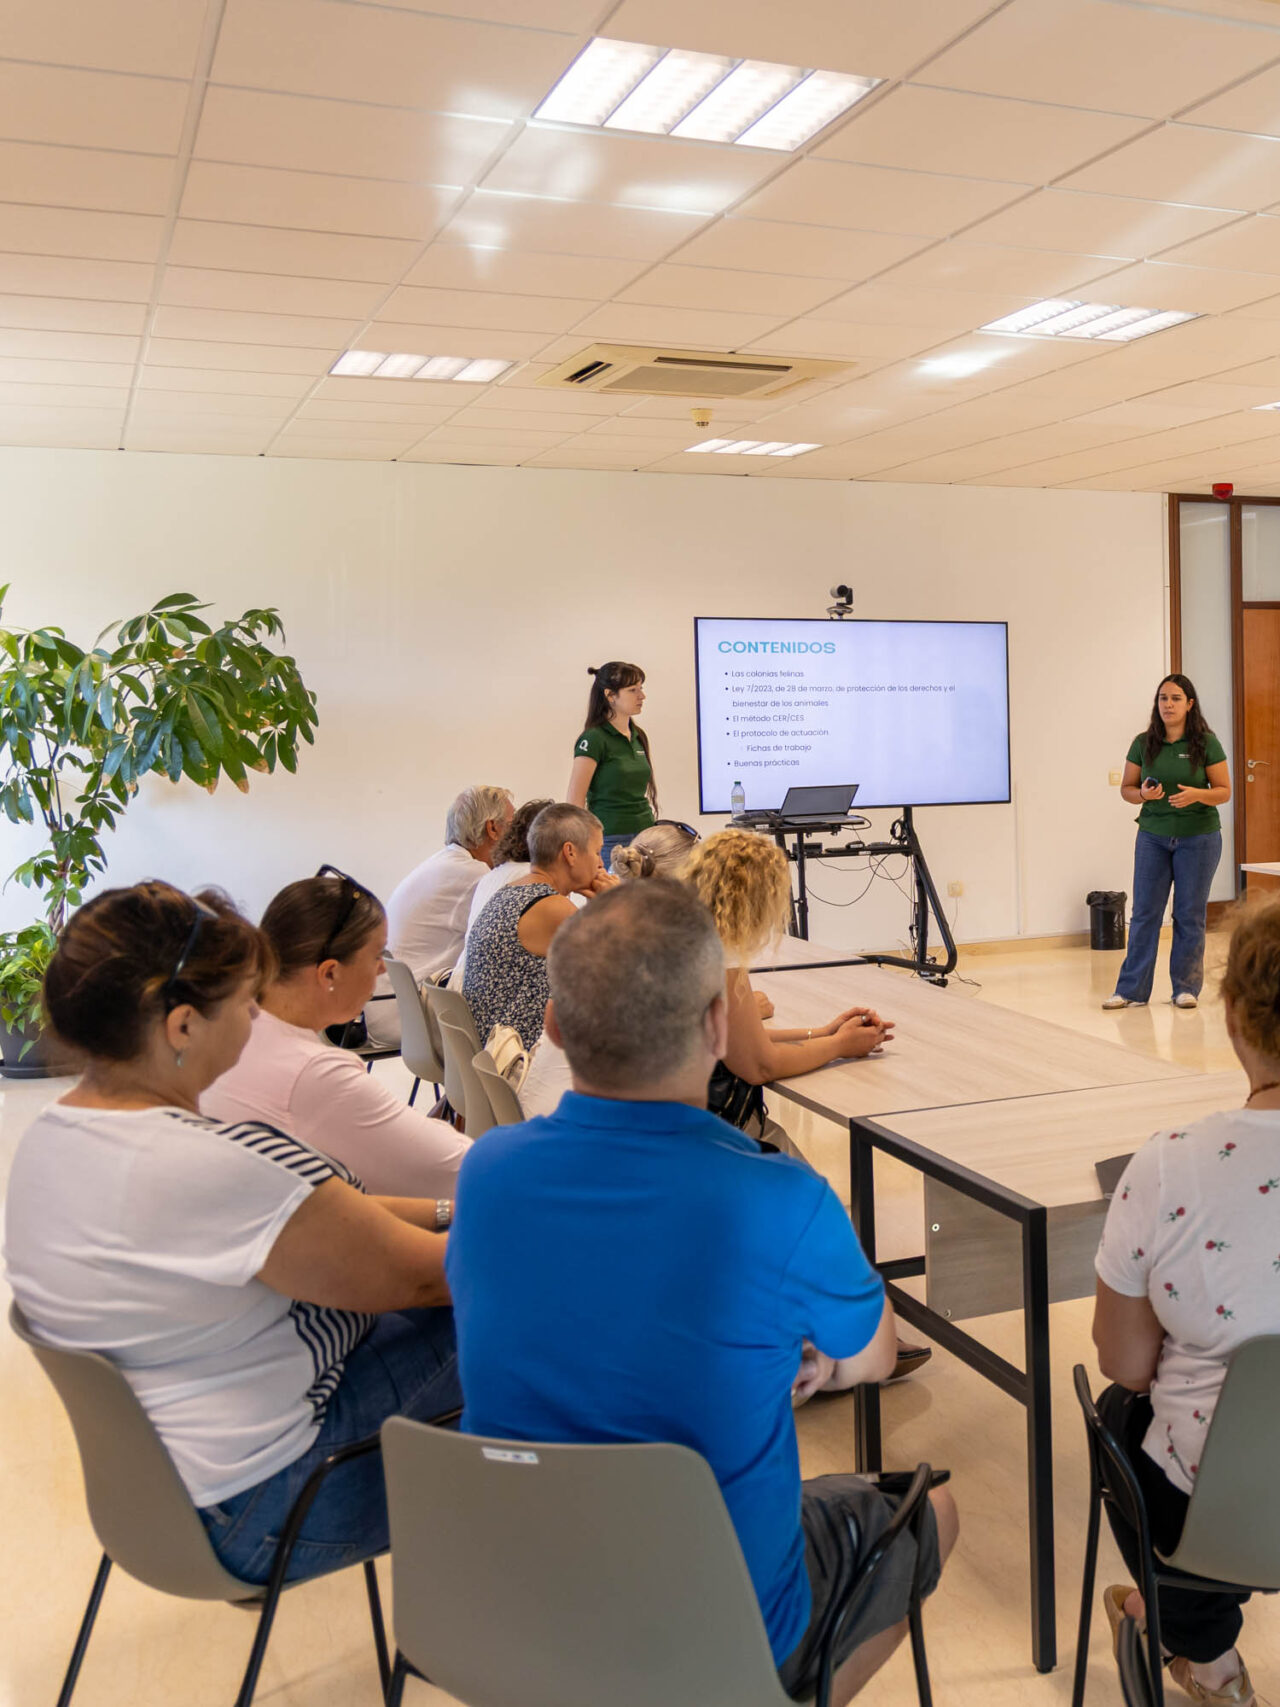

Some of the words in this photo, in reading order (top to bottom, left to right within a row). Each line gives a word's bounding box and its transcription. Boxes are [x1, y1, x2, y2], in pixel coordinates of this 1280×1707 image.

[718, 641, 836, 654] CONTENIDOS
[732, 669, 744, 677] Las
[746, 669, 778, 677] colonias
[780, 670, 804, 678] felinas
[732, 685, 744, 694] Ley
[747, 684, 774, 693] 7/2023,
[775, 684, 785, 692] de
[787, 684, 796, 692] 28
[797, 684, 807, 692] de
[847, 684, 885, 694] protección
[909, 684, 942, 692] derechos
[732, 700, 768, 708] bienestar
[770, 700, 780, 708] de
[782, 699, 792, 707] los
[794, 699, 828, 707] animales
[741, 715, 771, 723] método
[772, 713, 804, 722] CER/CES
[740, 730, 777, 740] protocolo
[779, 729, 789, 737] de
[791, 729, 828, 737] actuación
[747, 744, 771, 752] Fichas
[773, 744, 783, 752] de
[784, 743, 811, 753] trabajo
[734, 759, 763, 767] Buenas
[764, 759, 799, 768] prácticas
